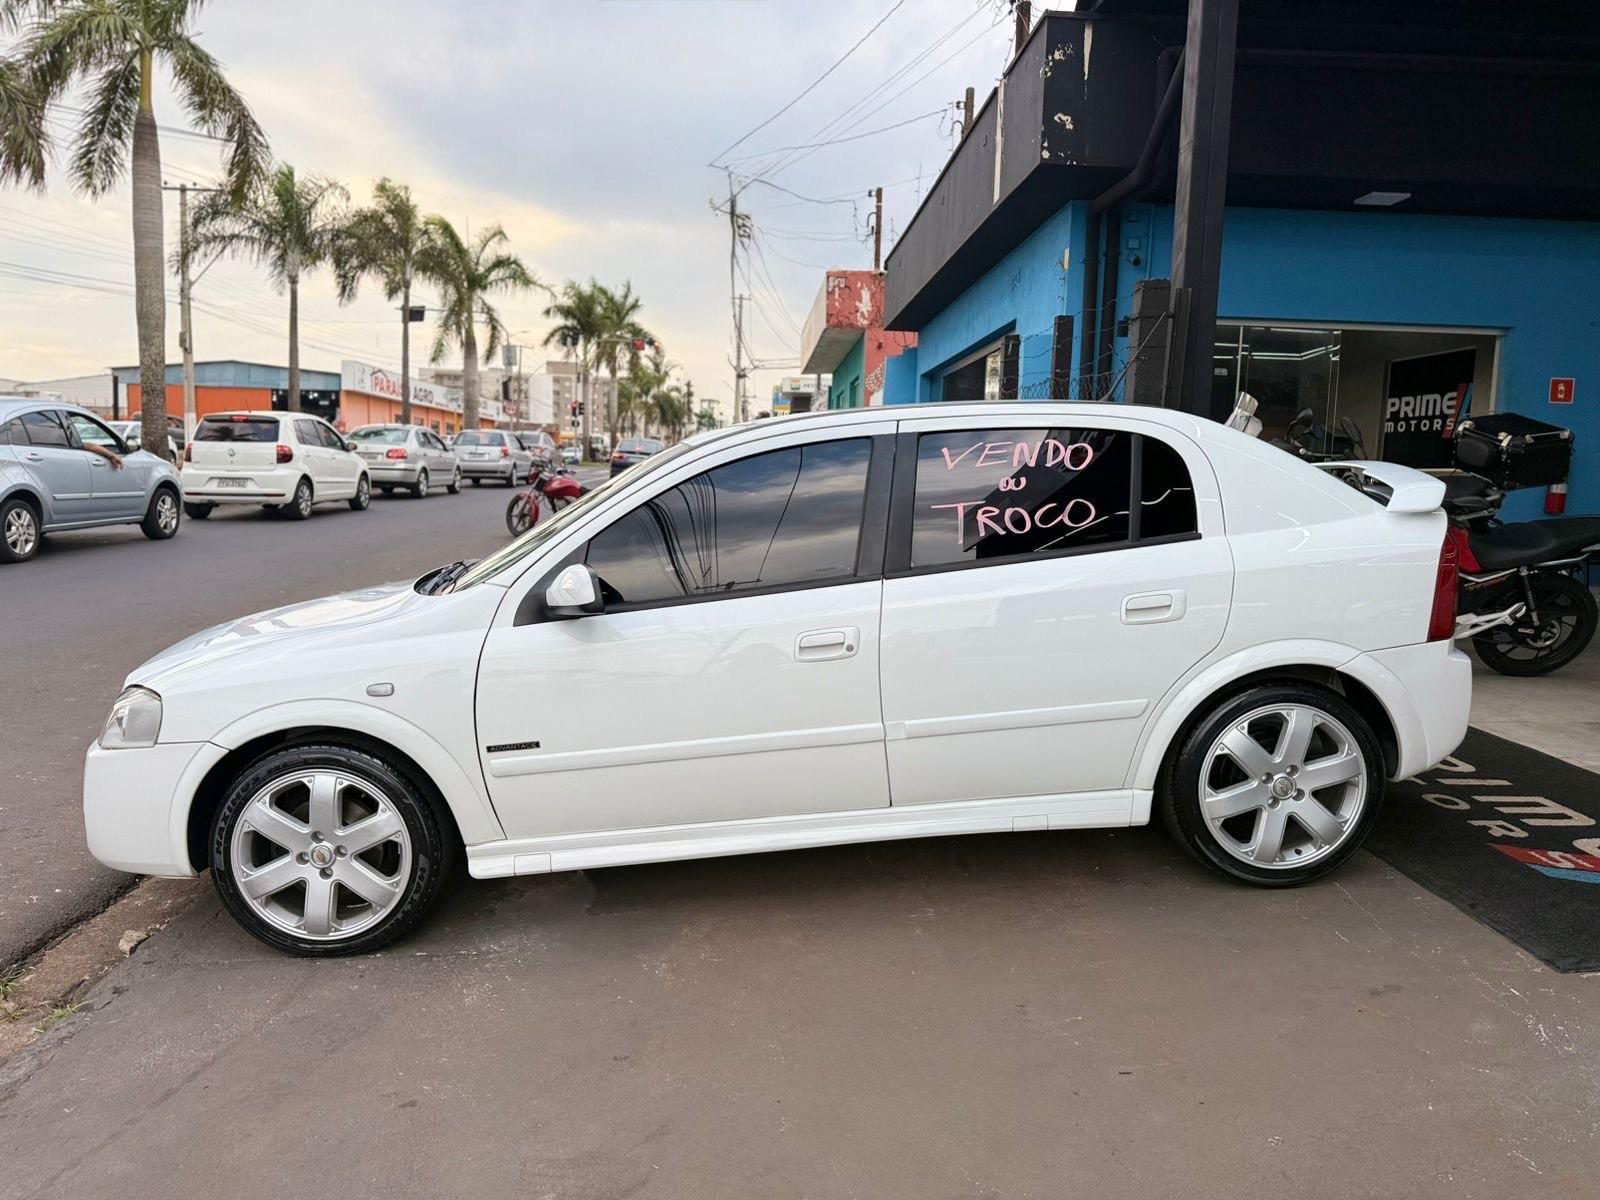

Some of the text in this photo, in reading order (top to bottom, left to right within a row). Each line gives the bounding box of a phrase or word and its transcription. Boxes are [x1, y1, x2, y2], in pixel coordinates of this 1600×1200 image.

[413, 386, 434, 404] AGRO
[1385, 391, 1458, 420] PRIME
[1384, 417, 1455, 434] MOTORS
[941, 438, 1094, 471] VENDO
[930, 498, 1096, 546] TROCO
